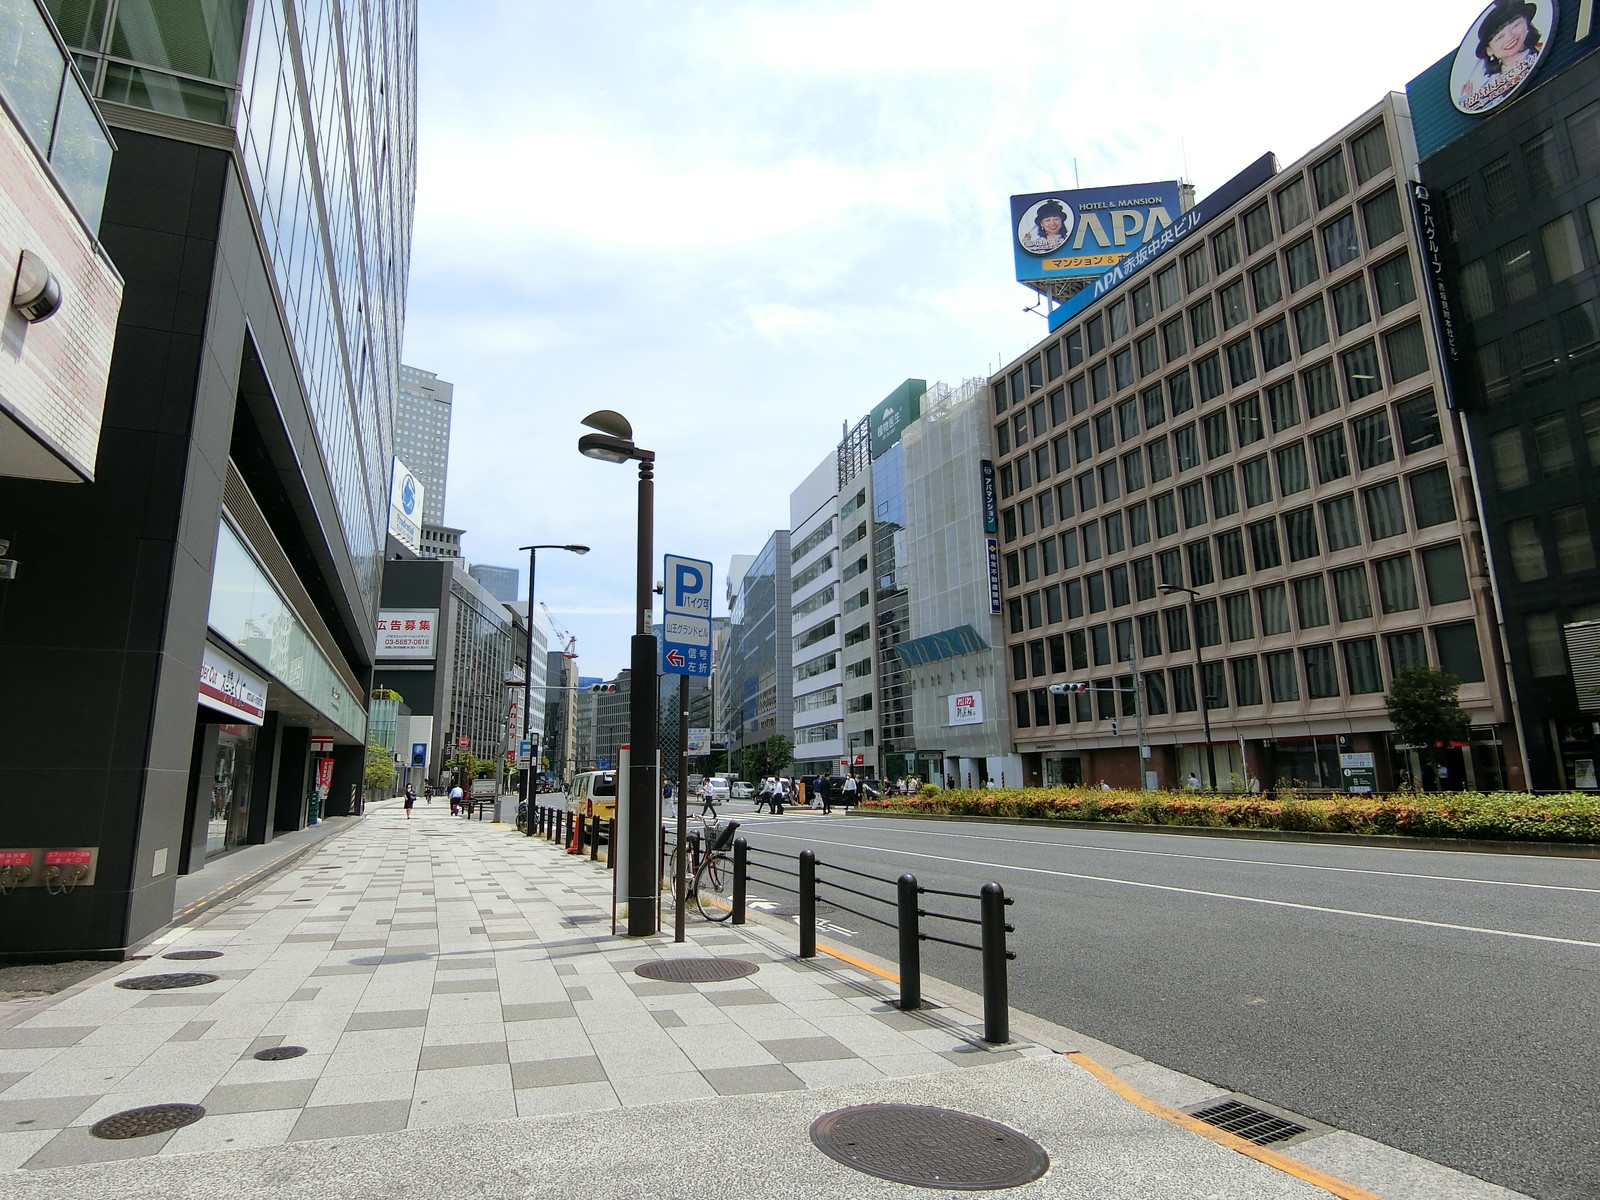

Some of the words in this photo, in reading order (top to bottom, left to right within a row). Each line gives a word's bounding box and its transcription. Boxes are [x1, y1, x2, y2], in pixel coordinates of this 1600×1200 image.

[1079, 201, 1108, 211] HOTEL
[1118, 196, 1162, 208] MANSION
[1072, 206, 1173, 249] APA
[1421, 203, 1442, 274] アパグループ
[1052, 256, 1103, 268] マンション
[1107, 255, 1114, 263] &
[985, 477, 995, 523] アパマンション
[675, 563, 703, 607] P
[989, 553, 1000, 606] 住友不動産販売
[683, 595, 709, 611] バイク可
[377, 619, 430, 631] 広告募集
[666, 622, 709, 638] 山王グランドビル
[687, 647, 708, 661] 信号
[687, 661, 708, 674] 左折
